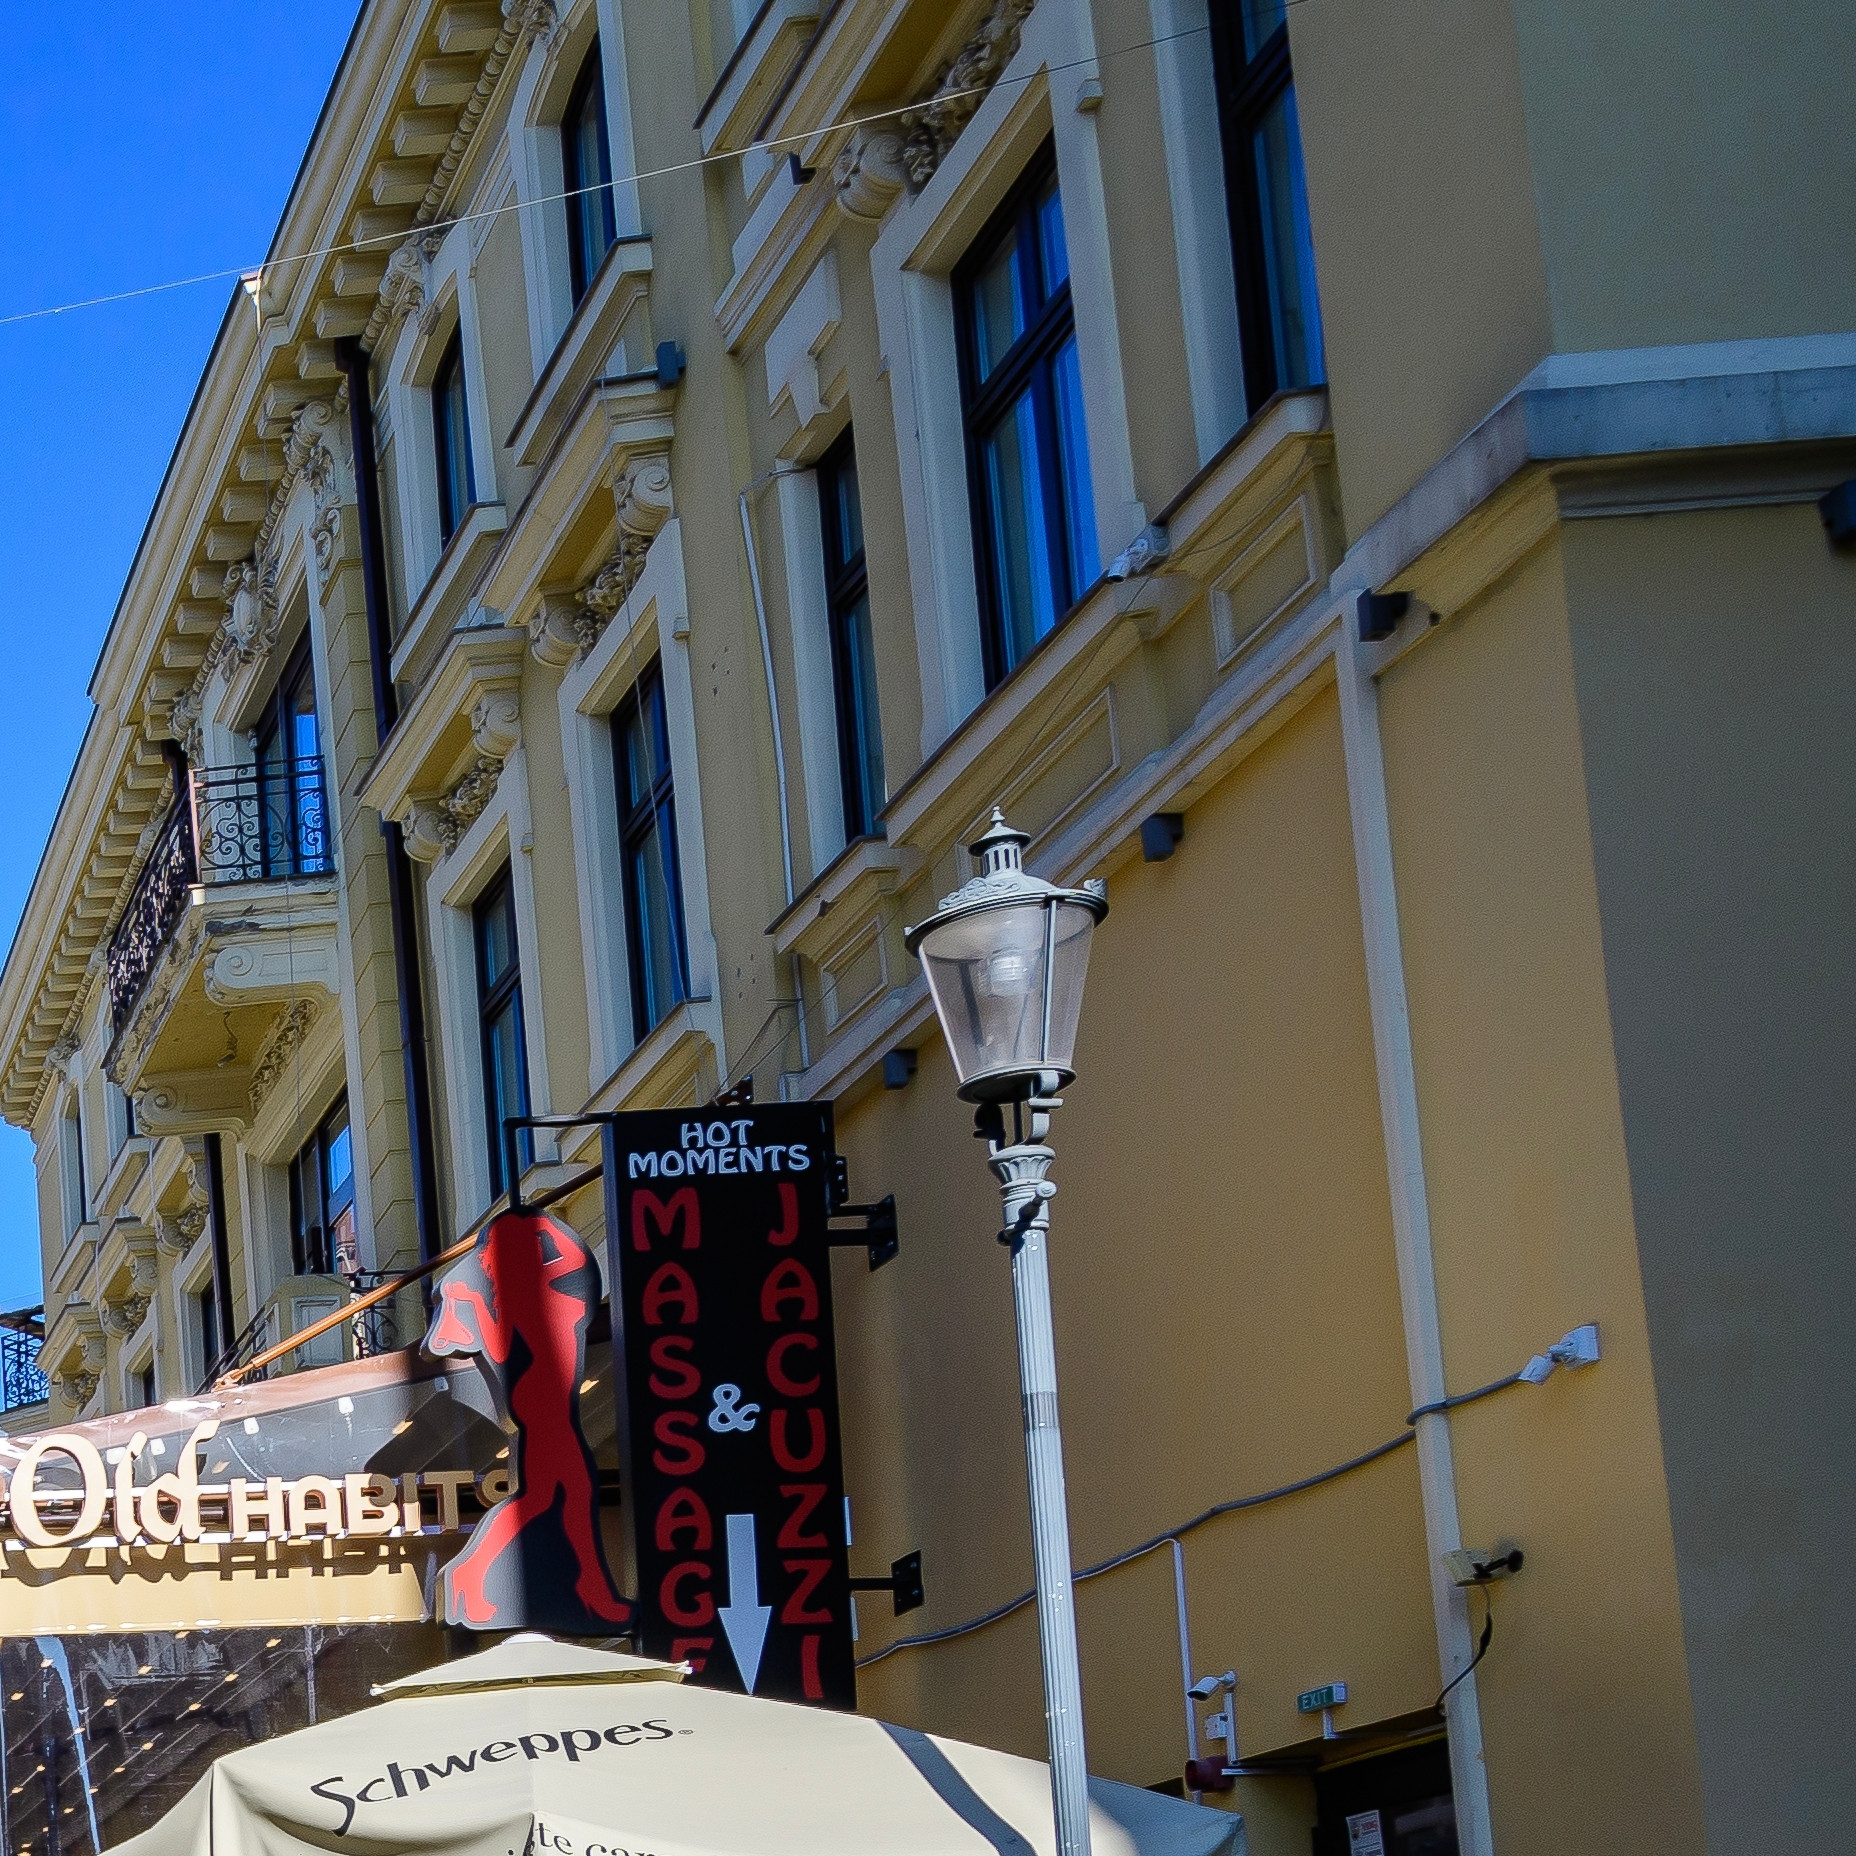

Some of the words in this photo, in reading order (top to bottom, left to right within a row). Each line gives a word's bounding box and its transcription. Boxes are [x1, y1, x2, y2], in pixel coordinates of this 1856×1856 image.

[680, 1120, 755, 1148] HOT
[628, 1143, 810, 1178] MOMENTS
[711, 1383, 759, 1433] &
[760, 1183, 834, 1699] JACUZZI
[11, 1419, 221, 1549] Old
[1301, 1688, 1329, 1710] EXIT
[311, 1715, 678, 1835] Schweppes
